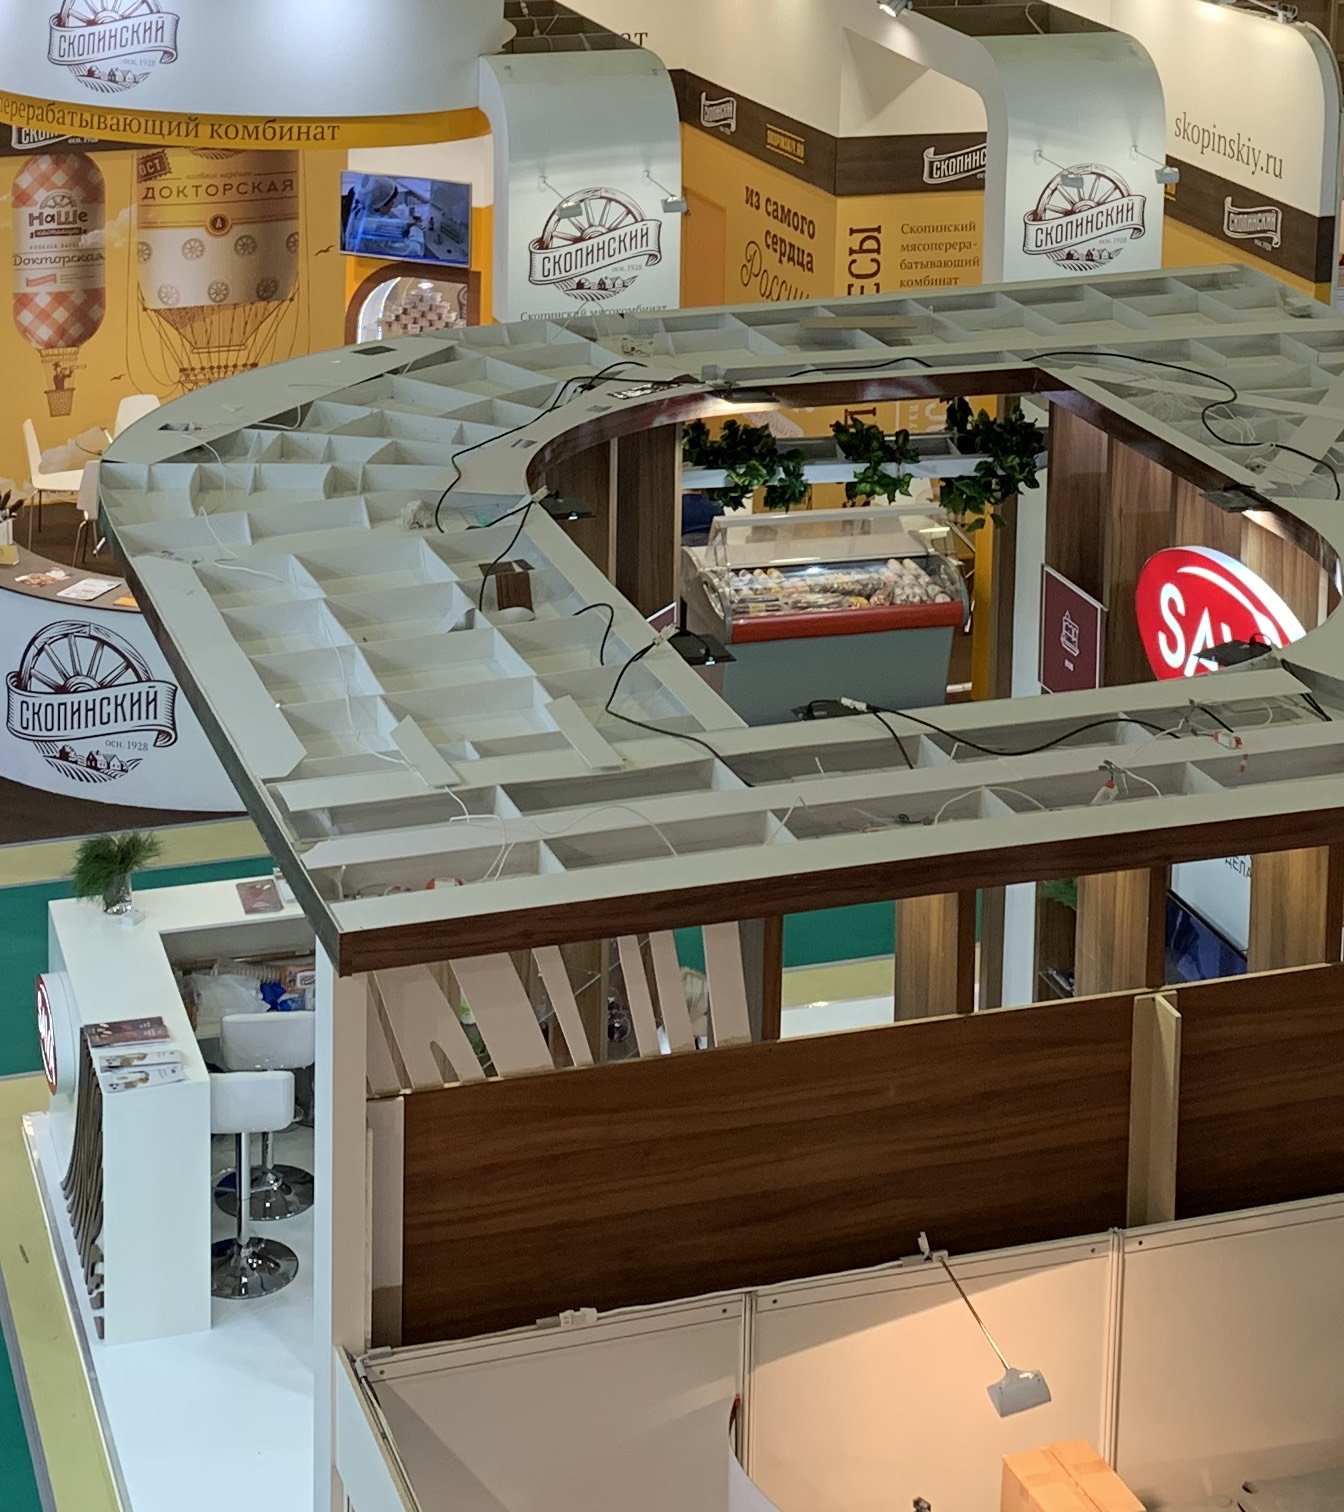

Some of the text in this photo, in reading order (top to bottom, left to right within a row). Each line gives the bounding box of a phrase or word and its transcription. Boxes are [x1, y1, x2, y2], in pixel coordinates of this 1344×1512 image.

[57, 16, 166, 59] СКОПИНСКИЙ
[209, 118, 341, 142] комбинат
[1174, 111, 1284, 179] skopinskiy.ru
[142, 179, 294, 201] ДОКТОРСКАЯ
[27, 210, 88, 228] Наше
[744, 185, 816, 241] из самого
[1034, 198, 1135, 249] СКОПИНСКИЙ
[900, 220, 976, 235] Скопинский
[542, 222, 649, 278] СКОПИНСКИЙ
[764, 228, 815, 274] сердца
[899, 241, 978, 254] мясоперера-
[12, 252, 105, 268] Докторская
[899, 256, 980, 272] батывающий
[899, 275, 960, 289] комбинат
[520, 309, 587, 322] Скопинский
[19, 685, 158, 733] СКОПИНСКИЙ
[127, 739, 149, 752] 1928
